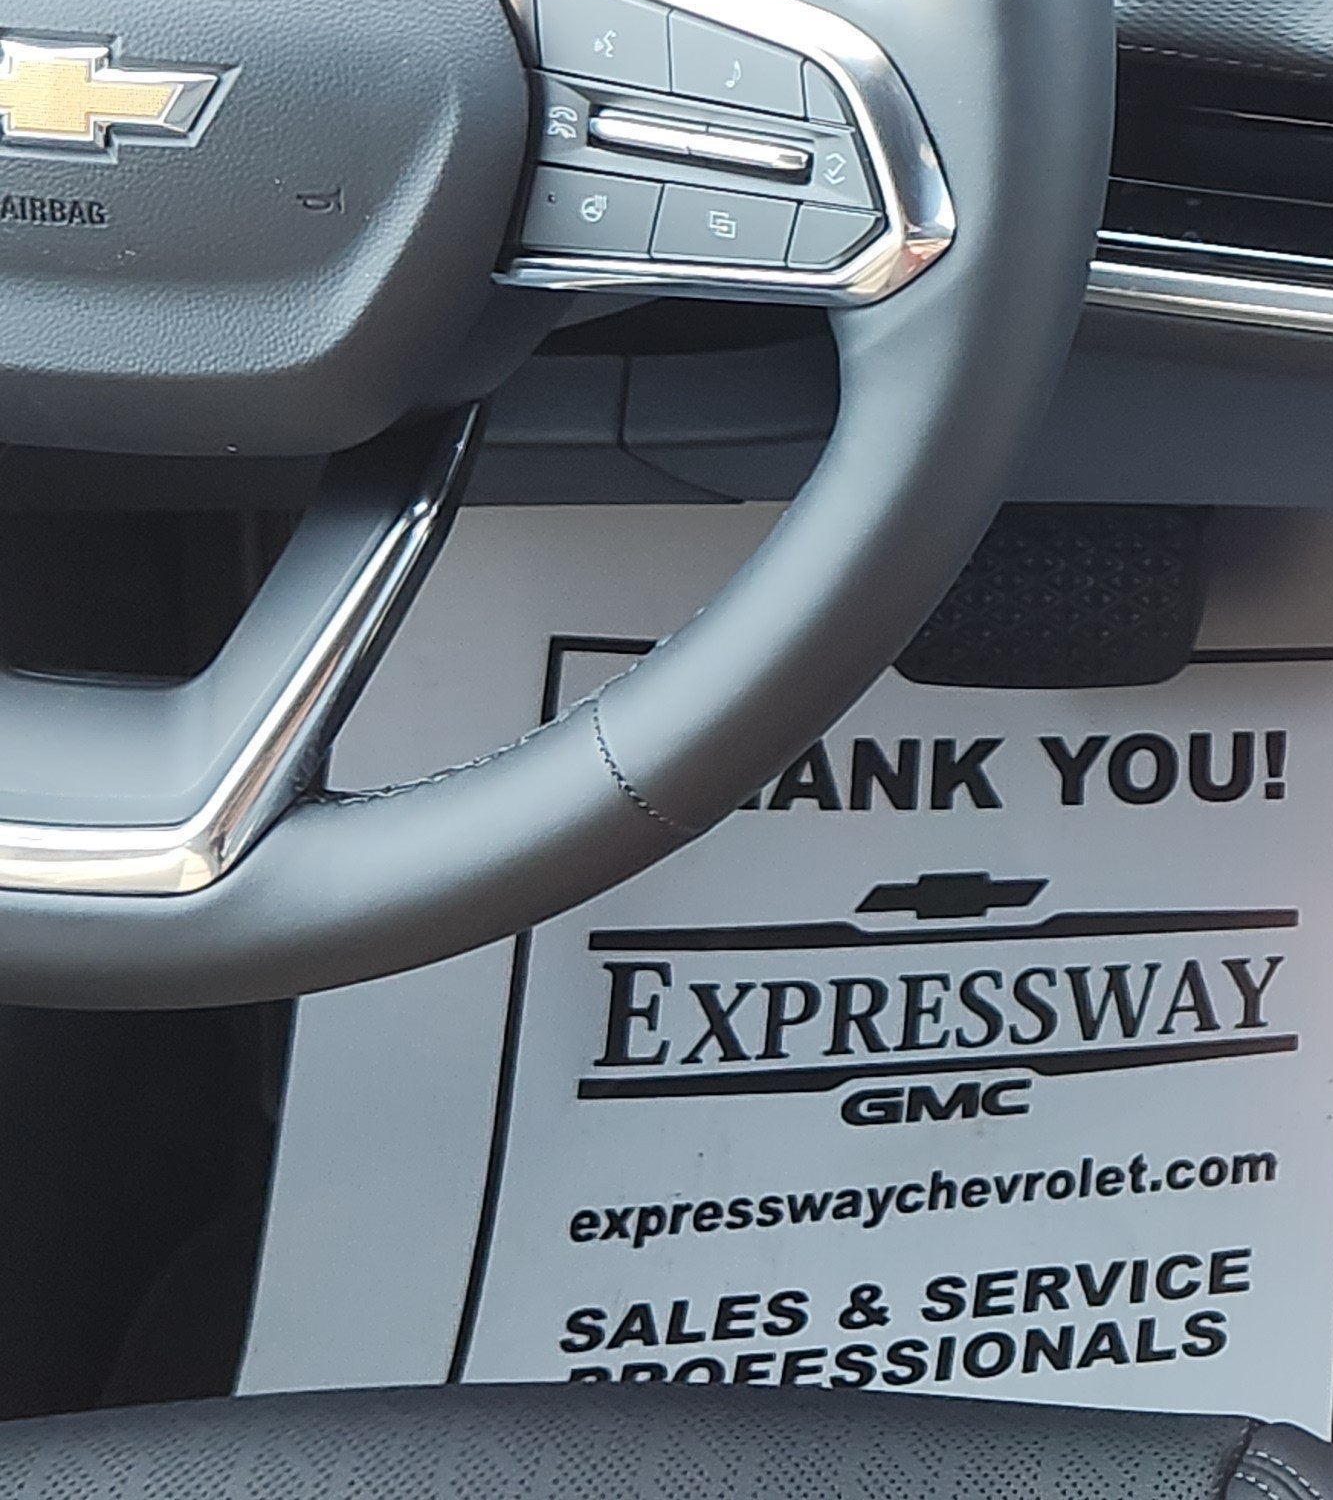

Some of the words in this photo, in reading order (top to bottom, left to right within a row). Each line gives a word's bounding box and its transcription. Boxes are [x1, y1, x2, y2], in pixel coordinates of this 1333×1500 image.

[0, 195, 107, 225] AIRBAG
[738, 736, 1004, 811] ANK
[1038, 729, 1287, 805] YOU!
[840, 1077, 1032, 1126] GMC
[569, 1150, 1279, 1249] expresswaychevrolet.com
[559, 1289, 809, 1354] SALES
[837, 1282, 890, 1332] &
[920, 1247, 1254, 1323] SERVICE
